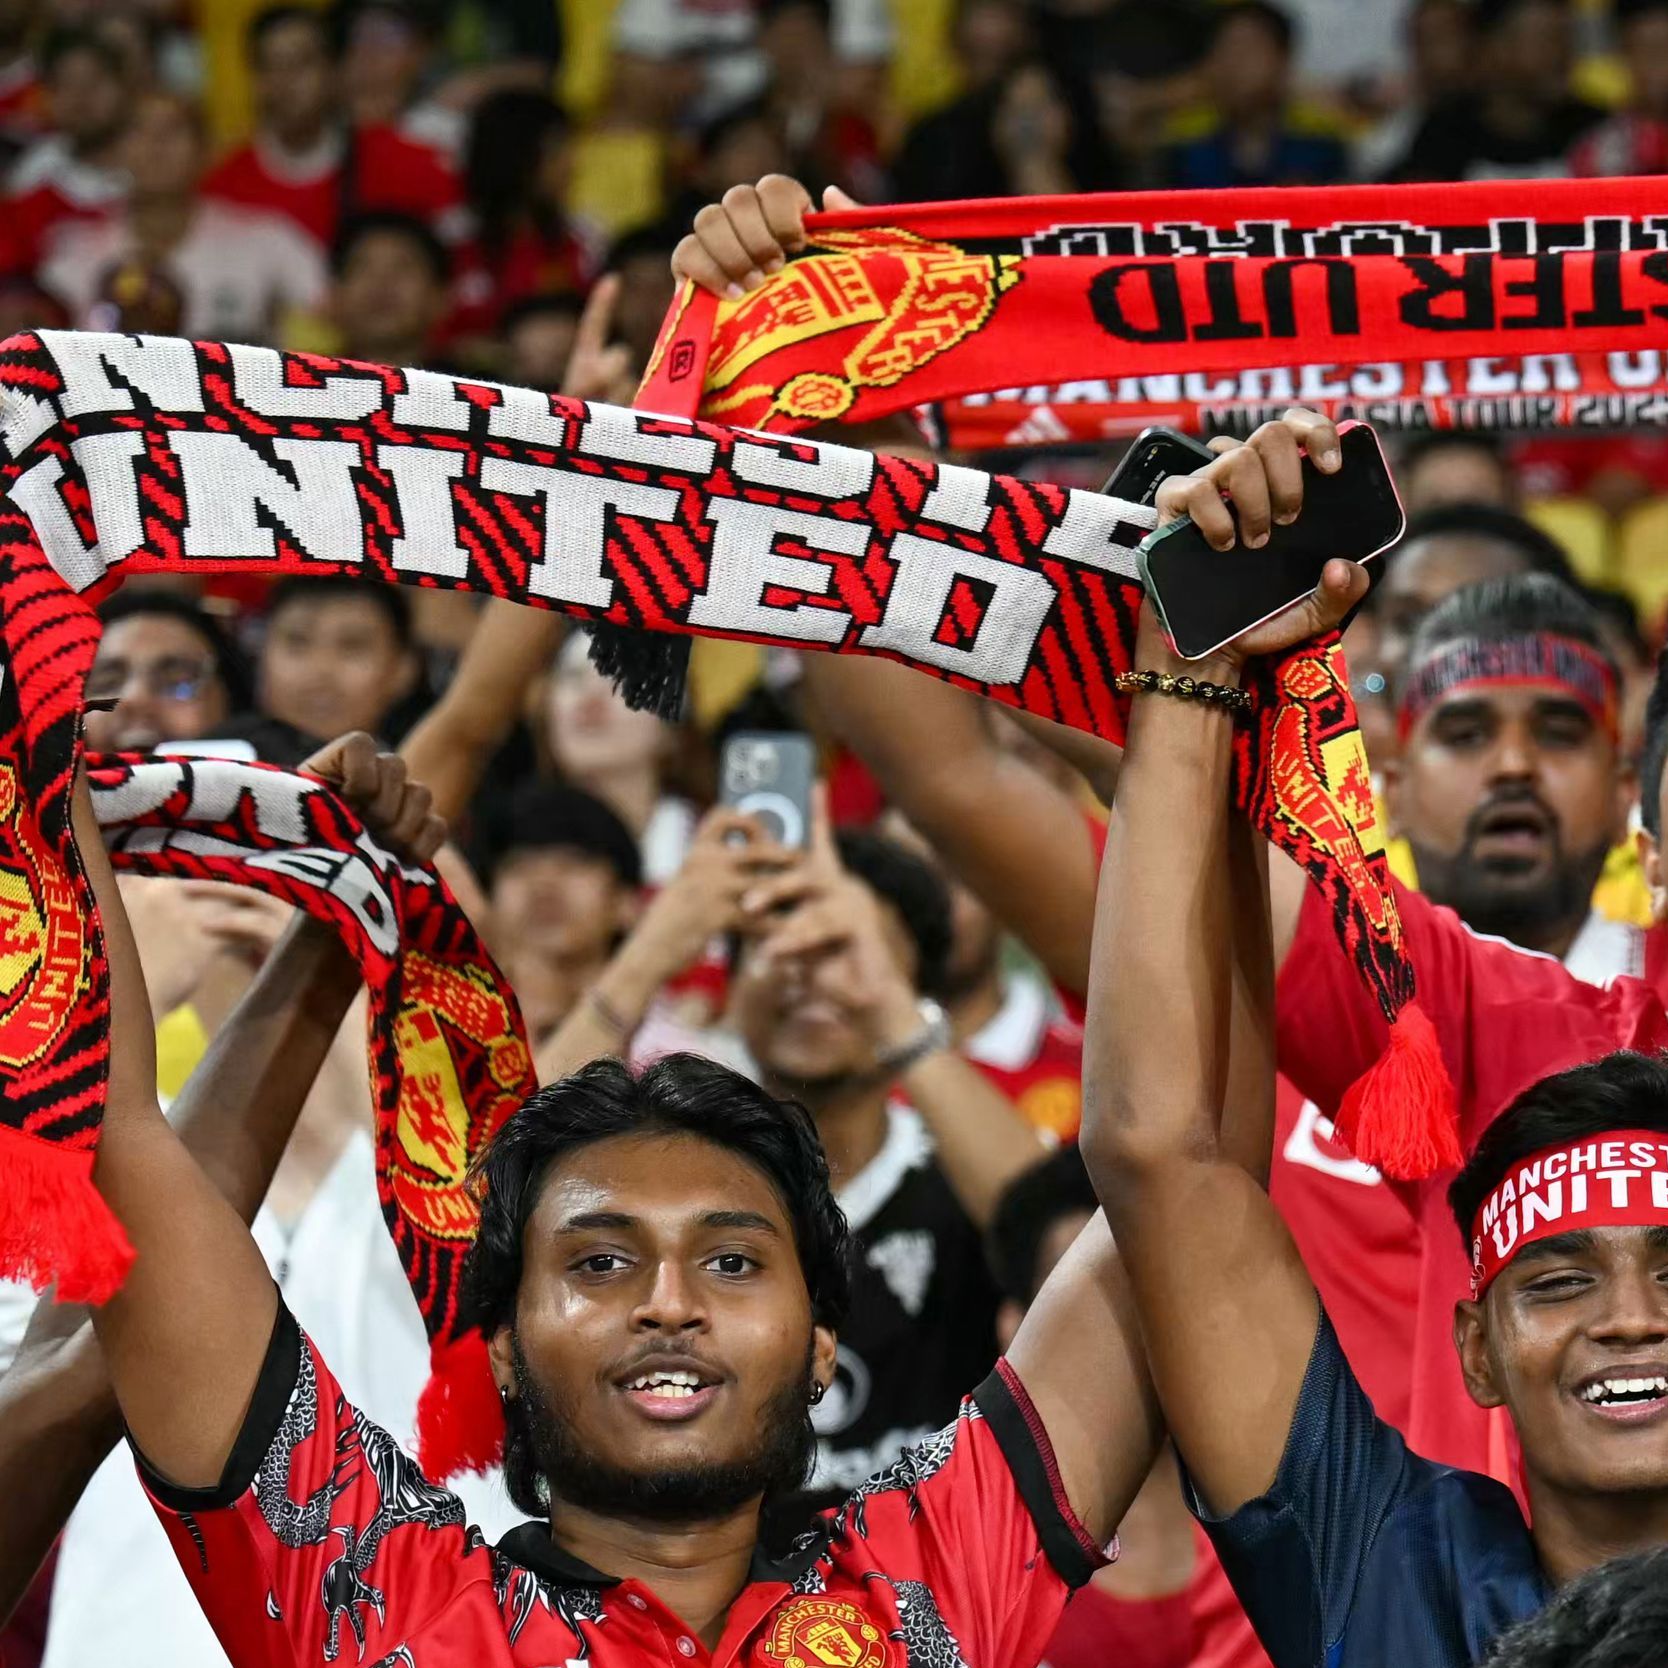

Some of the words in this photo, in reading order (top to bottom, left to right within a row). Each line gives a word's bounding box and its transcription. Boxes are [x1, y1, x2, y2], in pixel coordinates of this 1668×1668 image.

[1087, 256, 1361, 343] UTD
[10, 430, 1056, 686] UNITED
[777, 1604, 857, 1653] MANCHESTER
